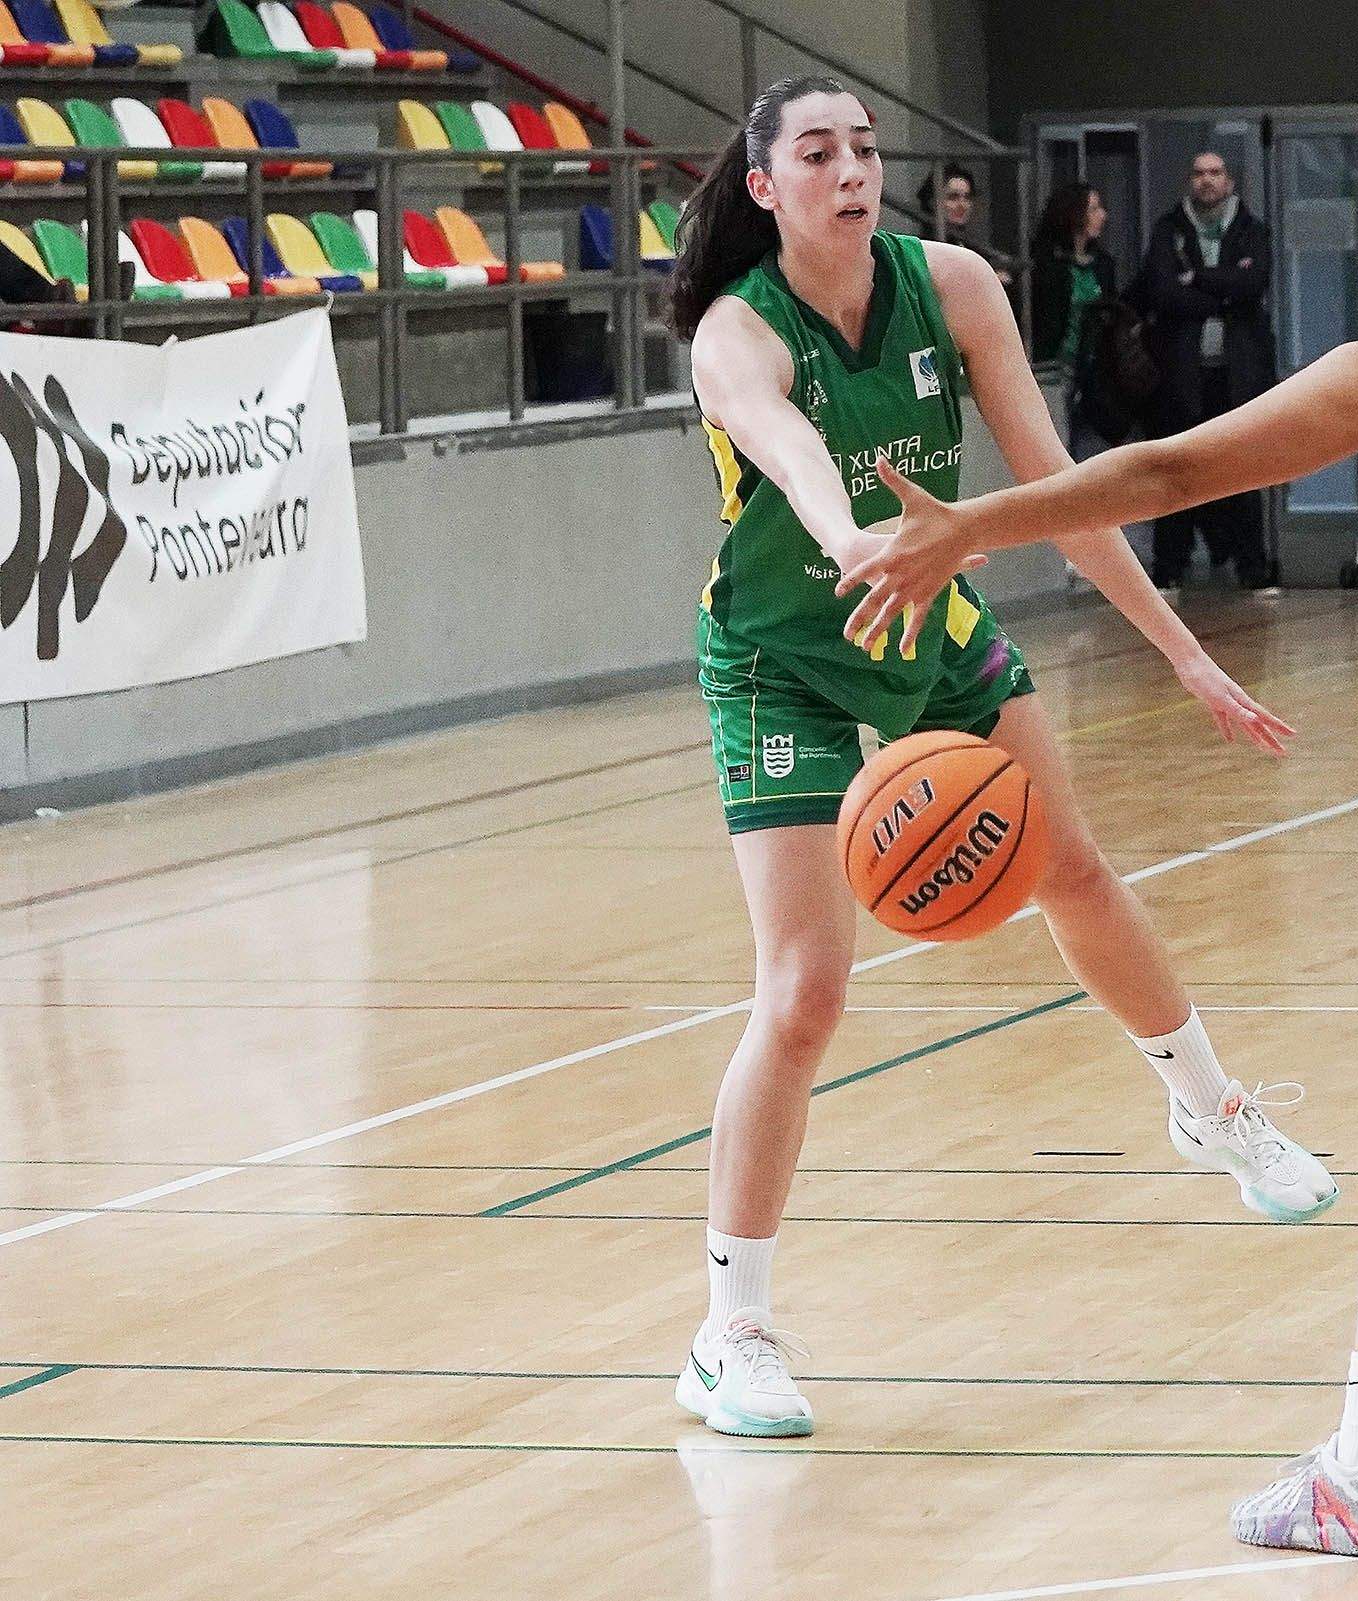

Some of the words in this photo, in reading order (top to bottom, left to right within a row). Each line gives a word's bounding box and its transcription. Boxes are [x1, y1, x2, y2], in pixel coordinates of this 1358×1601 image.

[849, 435, 921, 474] XUNTA
[851, 472, 878, 497] DE
[895, 444, 962, 476] ALICIA
[898, 808, 1012, 915] Wilson
